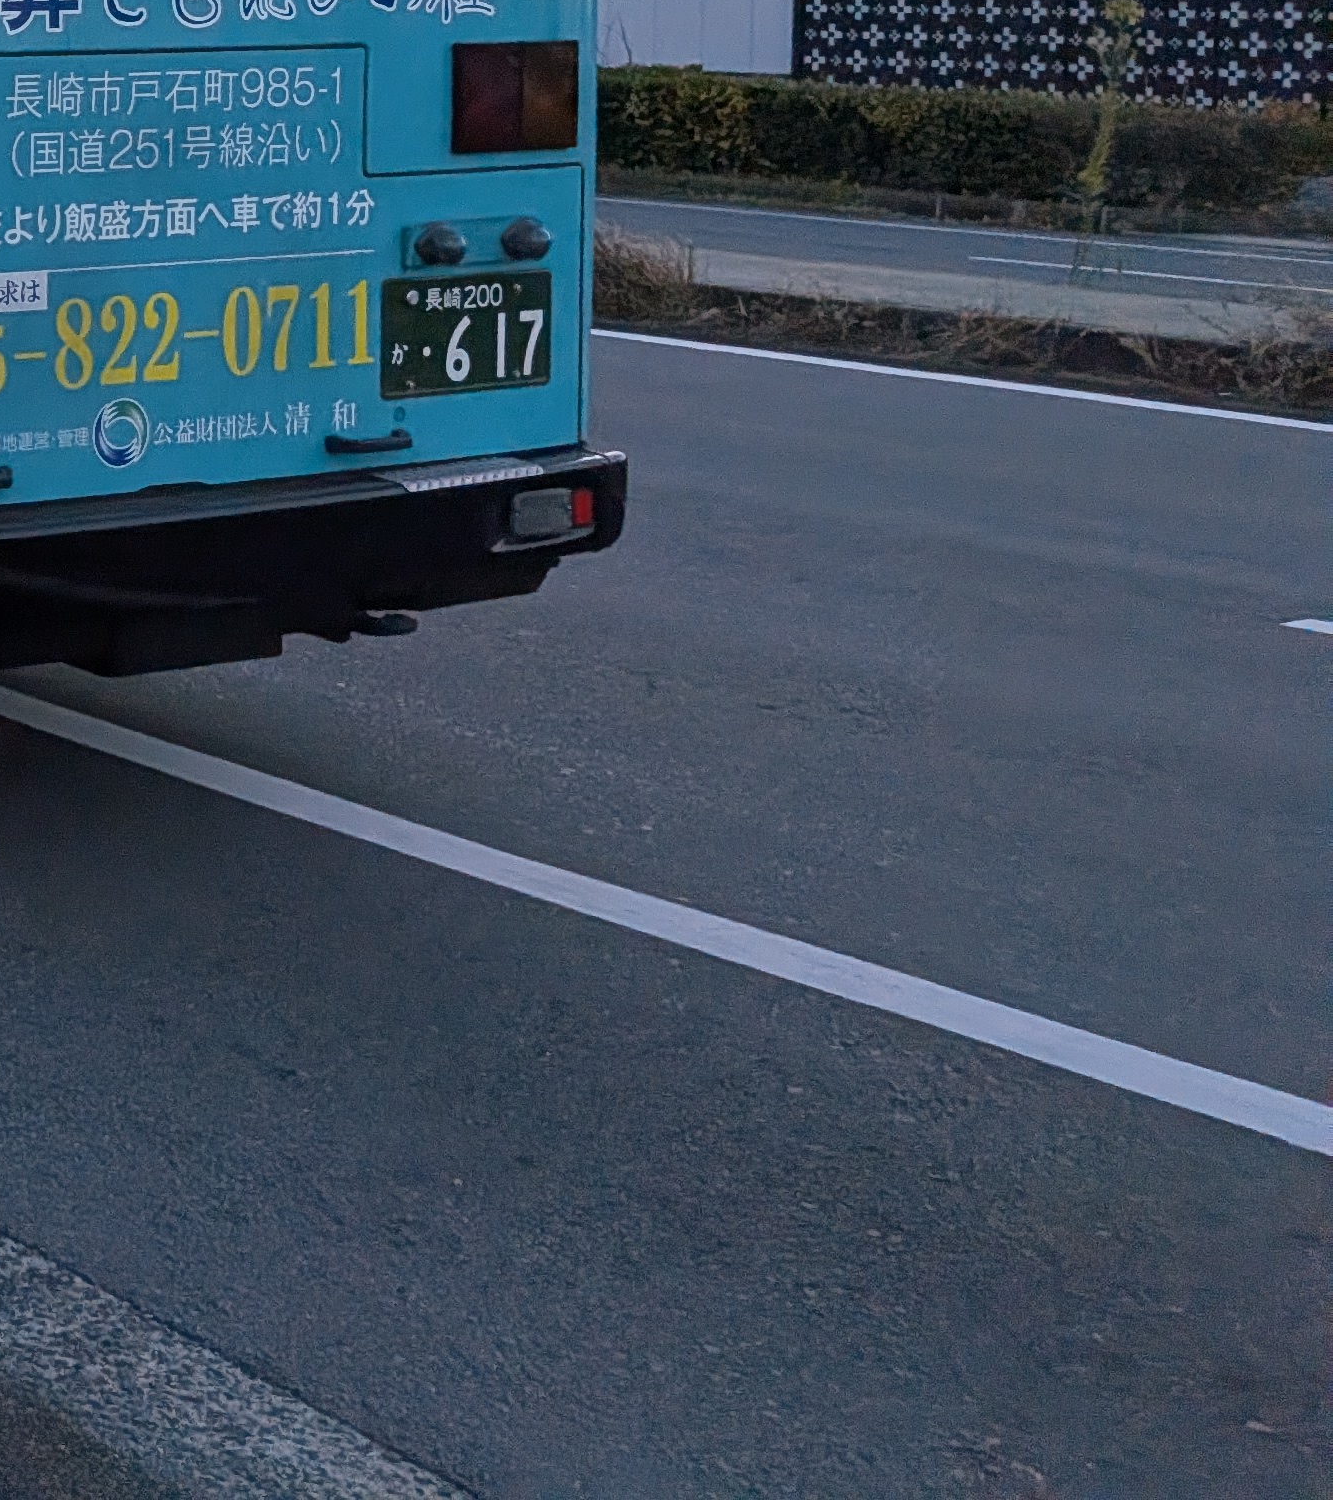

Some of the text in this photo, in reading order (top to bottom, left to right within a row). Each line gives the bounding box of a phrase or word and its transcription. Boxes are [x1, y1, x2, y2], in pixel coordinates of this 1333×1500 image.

[5, 66, 345, 120] 長崎市戸石町985-1
[425, 283, 503, 312] 長崎200
[391, 343, 409, 366] か
[153, 411, 278, 446] 公益財団法人
